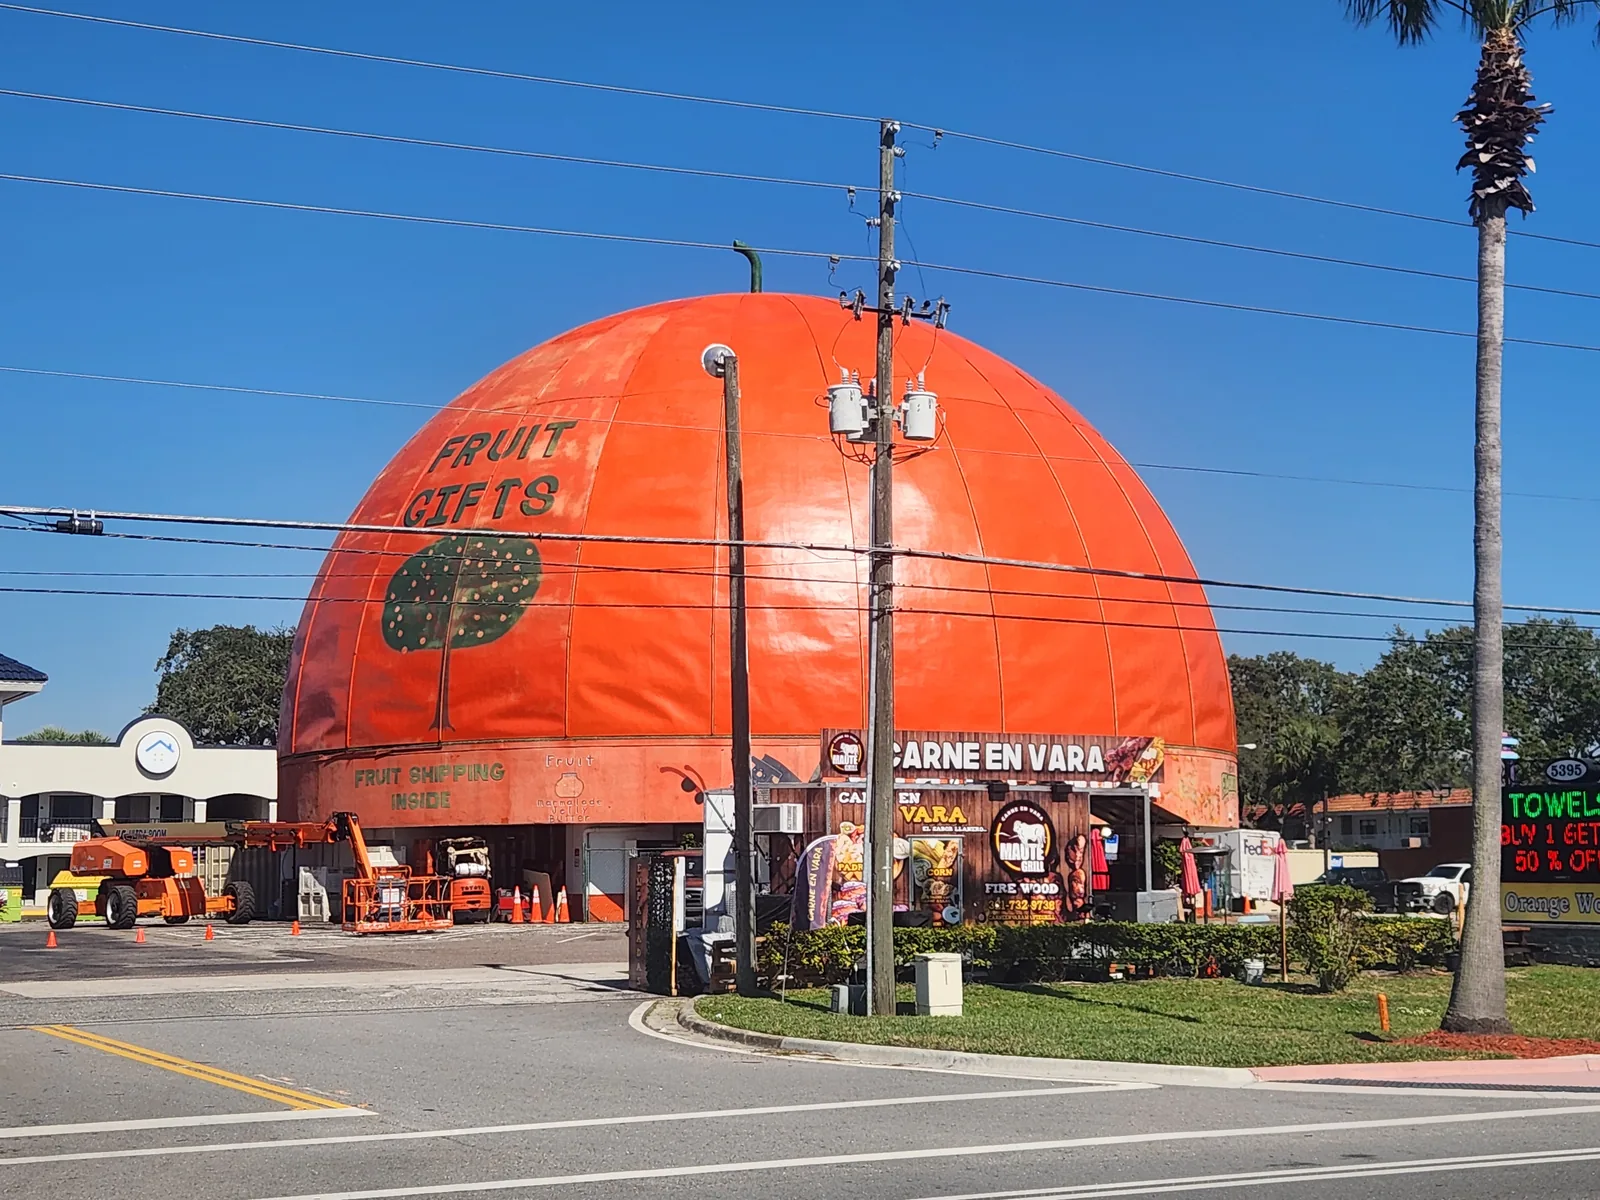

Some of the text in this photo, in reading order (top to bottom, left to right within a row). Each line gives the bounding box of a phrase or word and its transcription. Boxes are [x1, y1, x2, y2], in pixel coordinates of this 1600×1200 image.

[426, 420, 579, 474] FRUIT
[403, 474, 560, 528] GIFTS
[546, 755, 595, 767] Fruit
[985, 742, 1023, 770] EN
[1027, 743, 1105, 773] VARA
[355, 763, 506, 788] FRUIT SHIPPING
[1551, 764, 1582, 777] 5395
[391, 792, 452, 810] INSIDE
[898, 792, 921, 804] EN
[552, 806, 587, 814] Jelly
[899, 805, 967, 823] VARA
[1500, 822, 1600, 845] BUY 1 GET
[1000, 842, 1045, 860] MAUTE
[1243, 839, 1277, 856] FedEx
[838, 863, 863, 871] PADR
[1021, 860, 1045, 872] GRILL
[1515, 850, 1539, 872] 50
[1547, 850, 1563, 872] %
[927, 868, 953, 877] CORN
[808, 847, 823, 921] CARNE EN VARA
[985, 883, 1059, 894] FIRE WOOD
[1505, 893, 1570, 918] Orange
[635, 863, 643, 986] EMPANADAS
